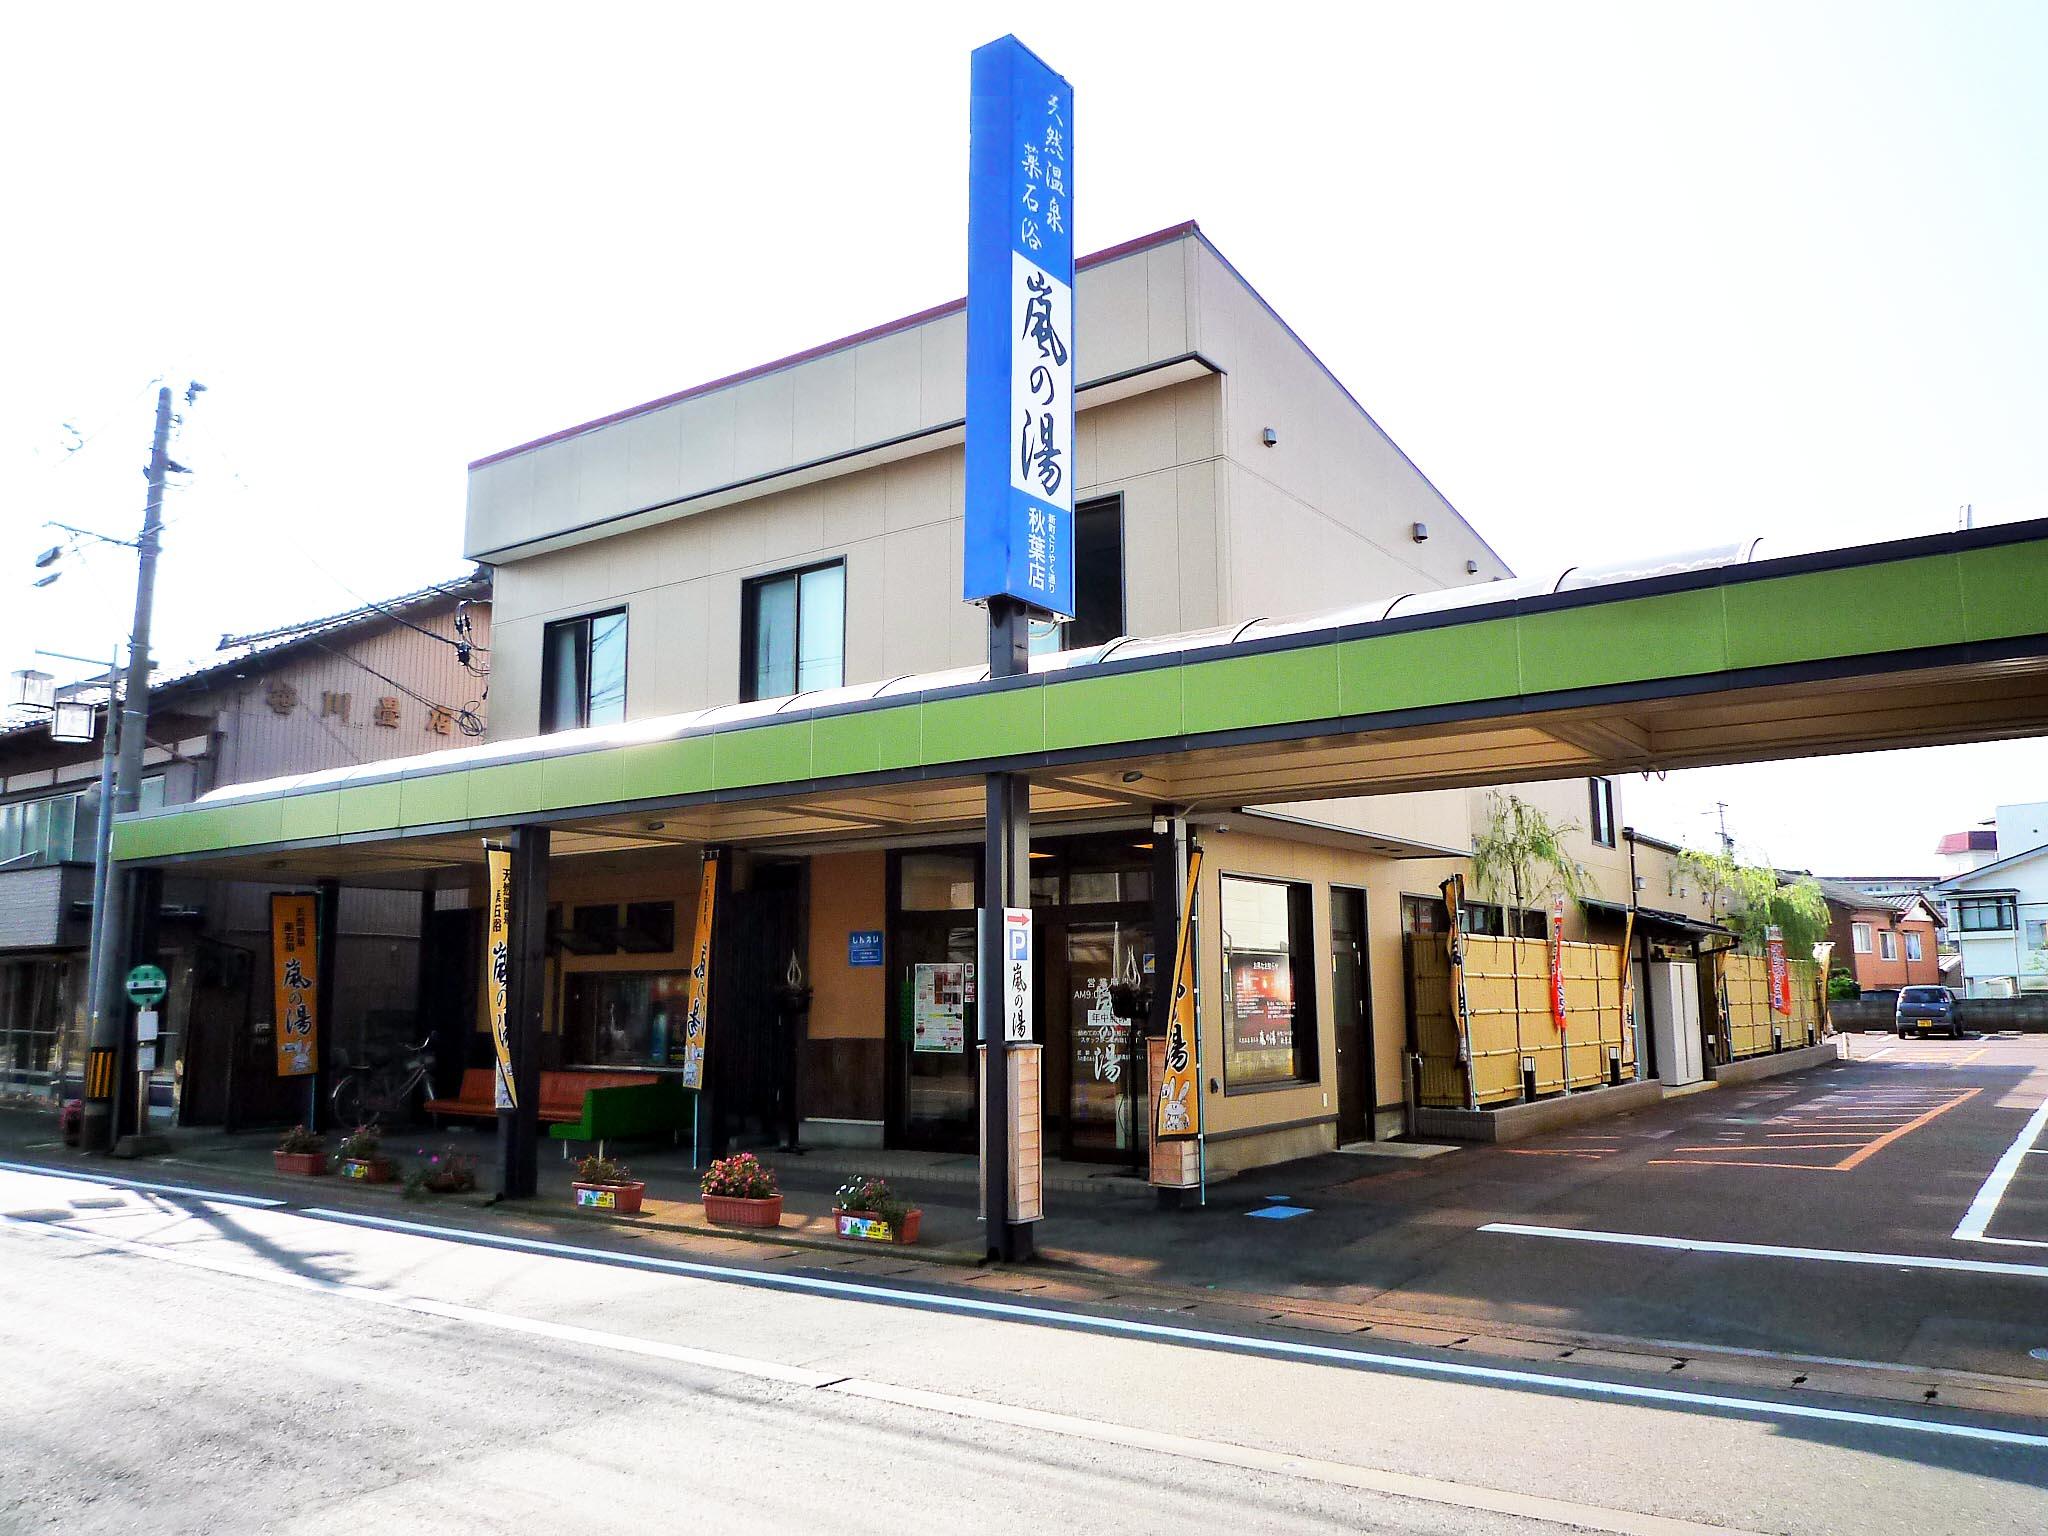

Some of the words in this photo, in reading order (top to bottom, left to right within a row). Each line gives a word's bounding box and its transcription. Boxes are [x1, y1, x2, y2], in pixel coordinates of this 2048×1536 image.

[1021, 143, 1043, 251] 薬石浴
[1045, 95, 1066, 234] 天然温泉
[1021, 271, 1068, 497] 嵐の湯
[1028, 507, 1046, 592] 秋葉店
[1012, 930, 1026, 959] P
[283, 958, 313, 1036] 嵐の湯
[1011, 962, 1028, 1038] 嵐の湯
